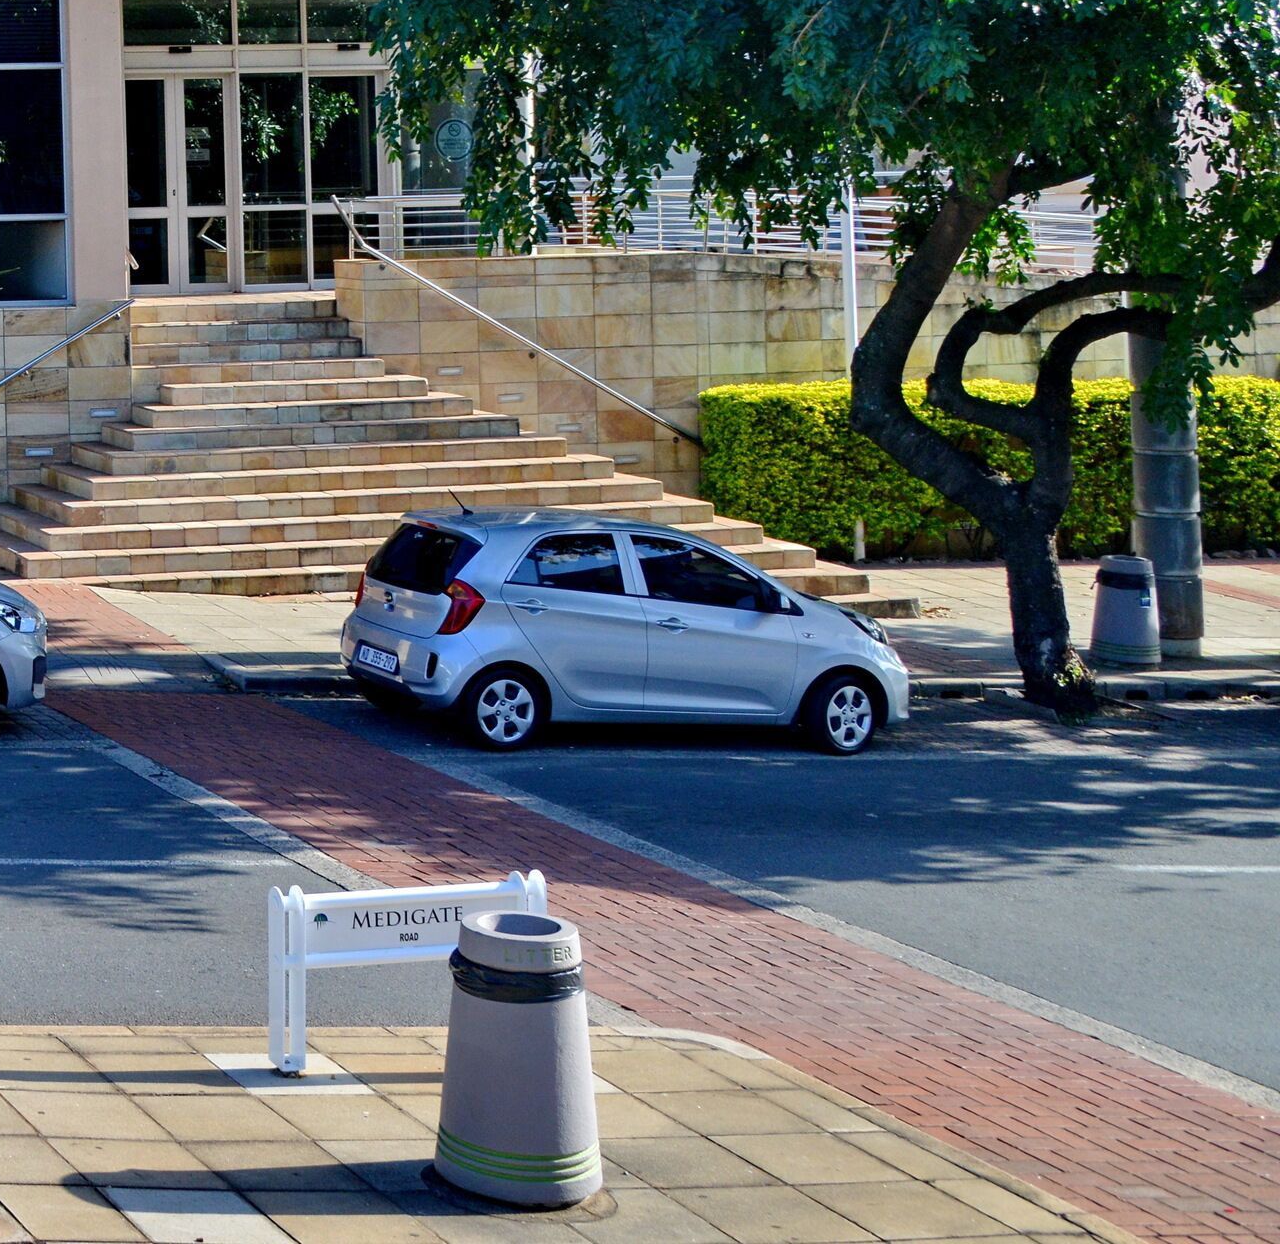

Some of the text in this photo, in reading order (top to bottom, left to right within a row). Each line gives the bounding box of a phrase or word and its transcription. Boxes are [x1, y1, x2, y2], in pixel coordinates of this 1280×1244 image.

[361, 648, 370, 660] ND
[352, 906, 463, 929] MEDIGATE
[399, 932, 419, 942] ROAD
[504, 945, 572, 964] LITTER
